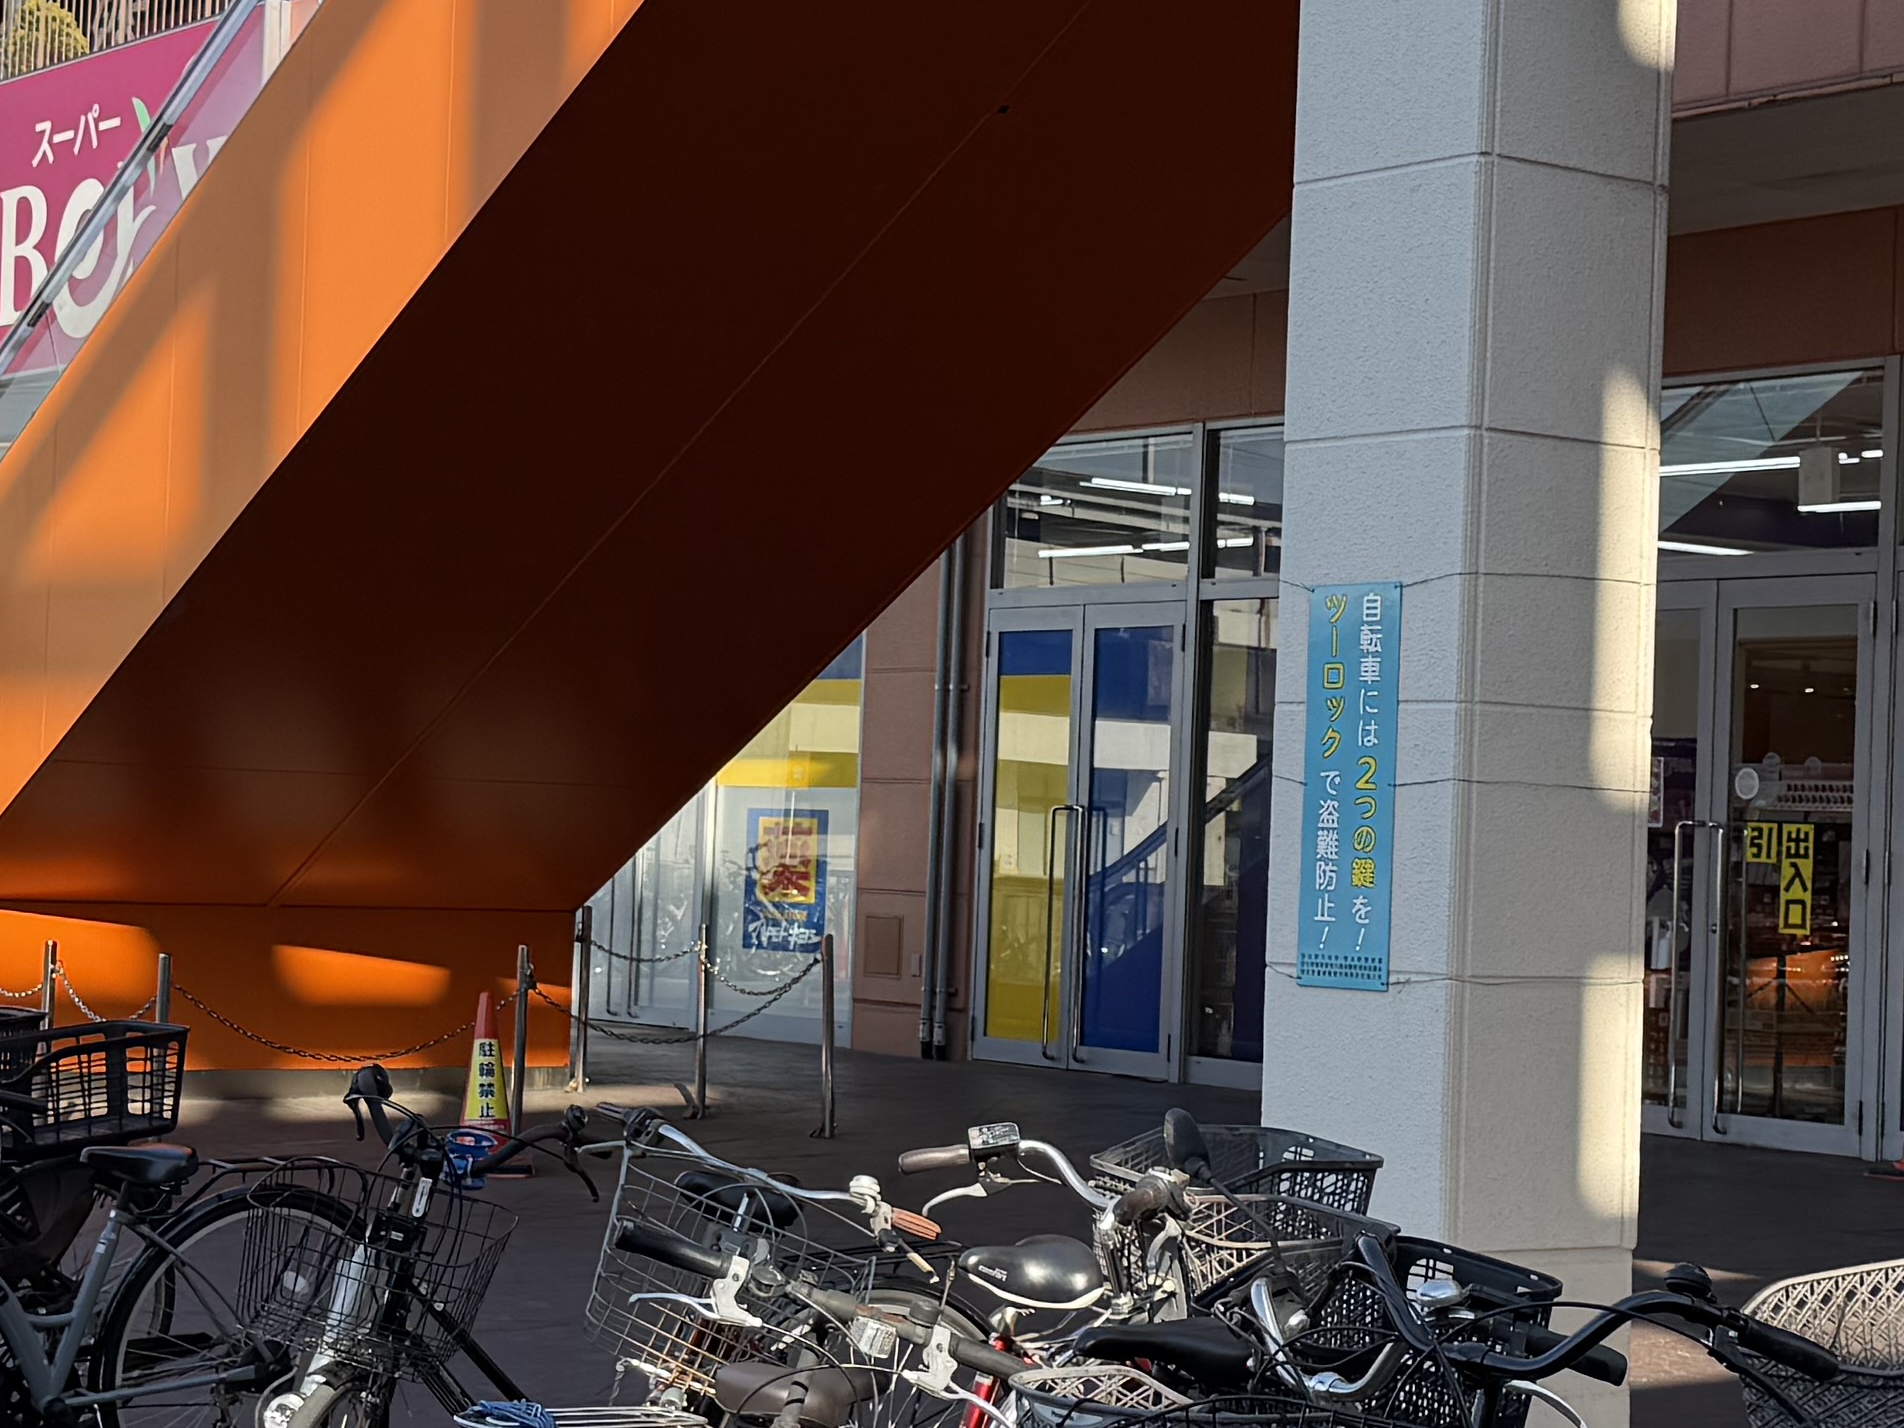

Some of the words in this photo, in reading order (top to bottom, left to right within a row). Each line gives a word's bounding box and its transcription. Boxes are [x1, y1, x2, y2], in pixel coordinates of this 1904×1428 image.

[32, 103, 121, 167] スーパー
[1748, 826, 1773, 860] 引
[1783, 827, 1809, 931] 出入口
[479, 1042, 496, 1118] 駐輪禁止
